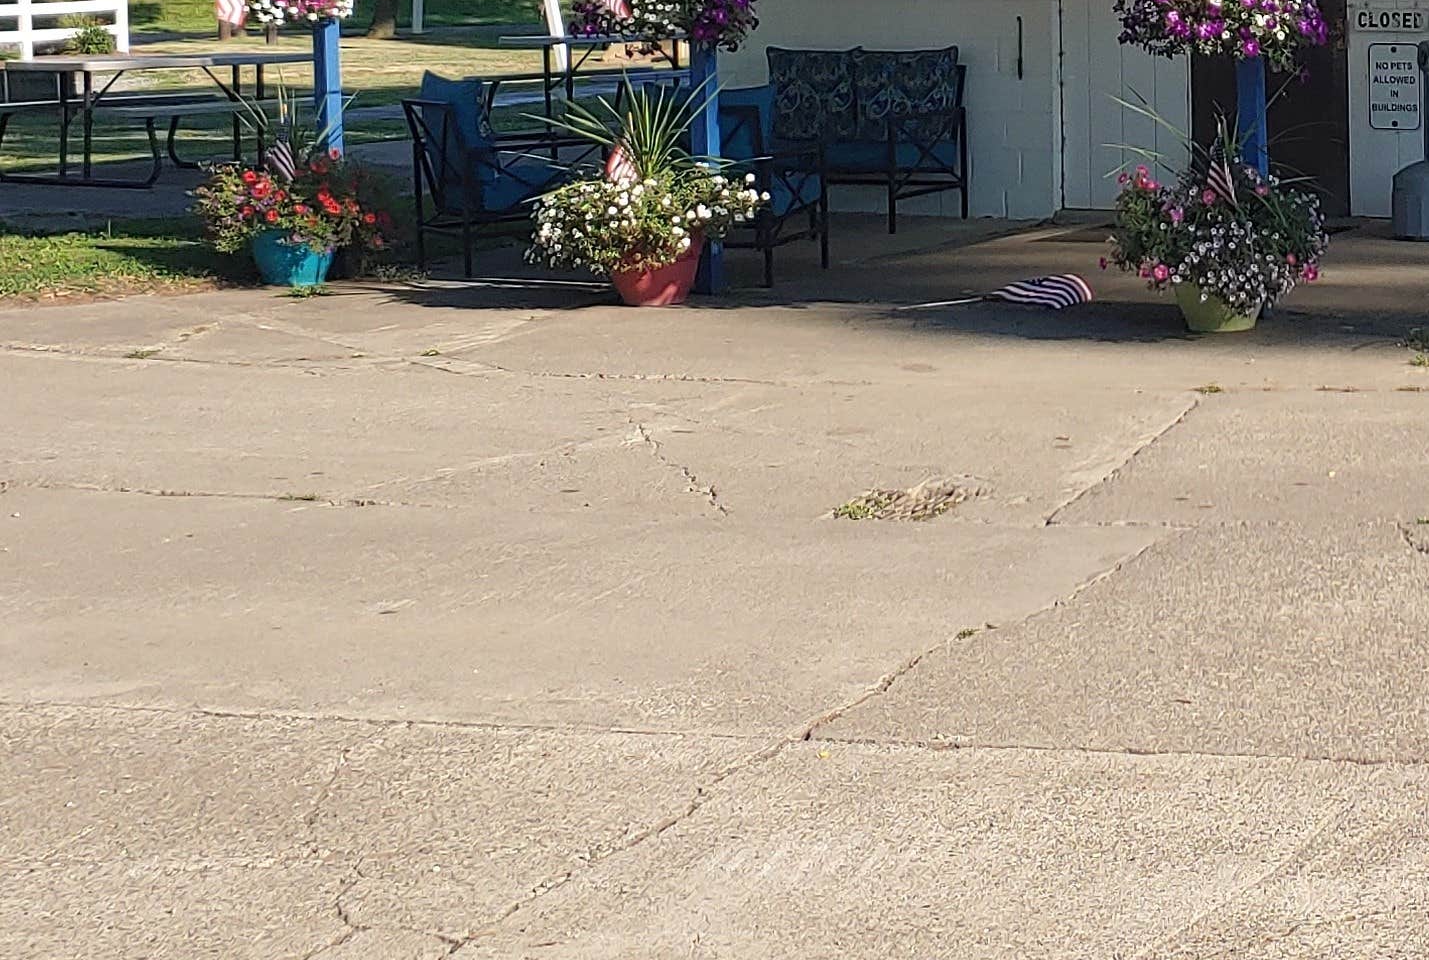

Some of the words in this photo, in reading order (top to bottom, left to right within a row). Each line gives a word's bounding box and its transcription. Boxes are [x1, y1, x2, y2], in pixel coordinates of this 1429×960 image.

[1357, 11, 1424, 29] CLOSED
[1375, 61, 1389, 70] NO
[1390, 61, 1413, 71] PETS
[1372, 75, 1416, 85] ALLOWED
[1390, 89, 1399, 98] IN
[1371, 103, 1418, 112] BUILDINGS
